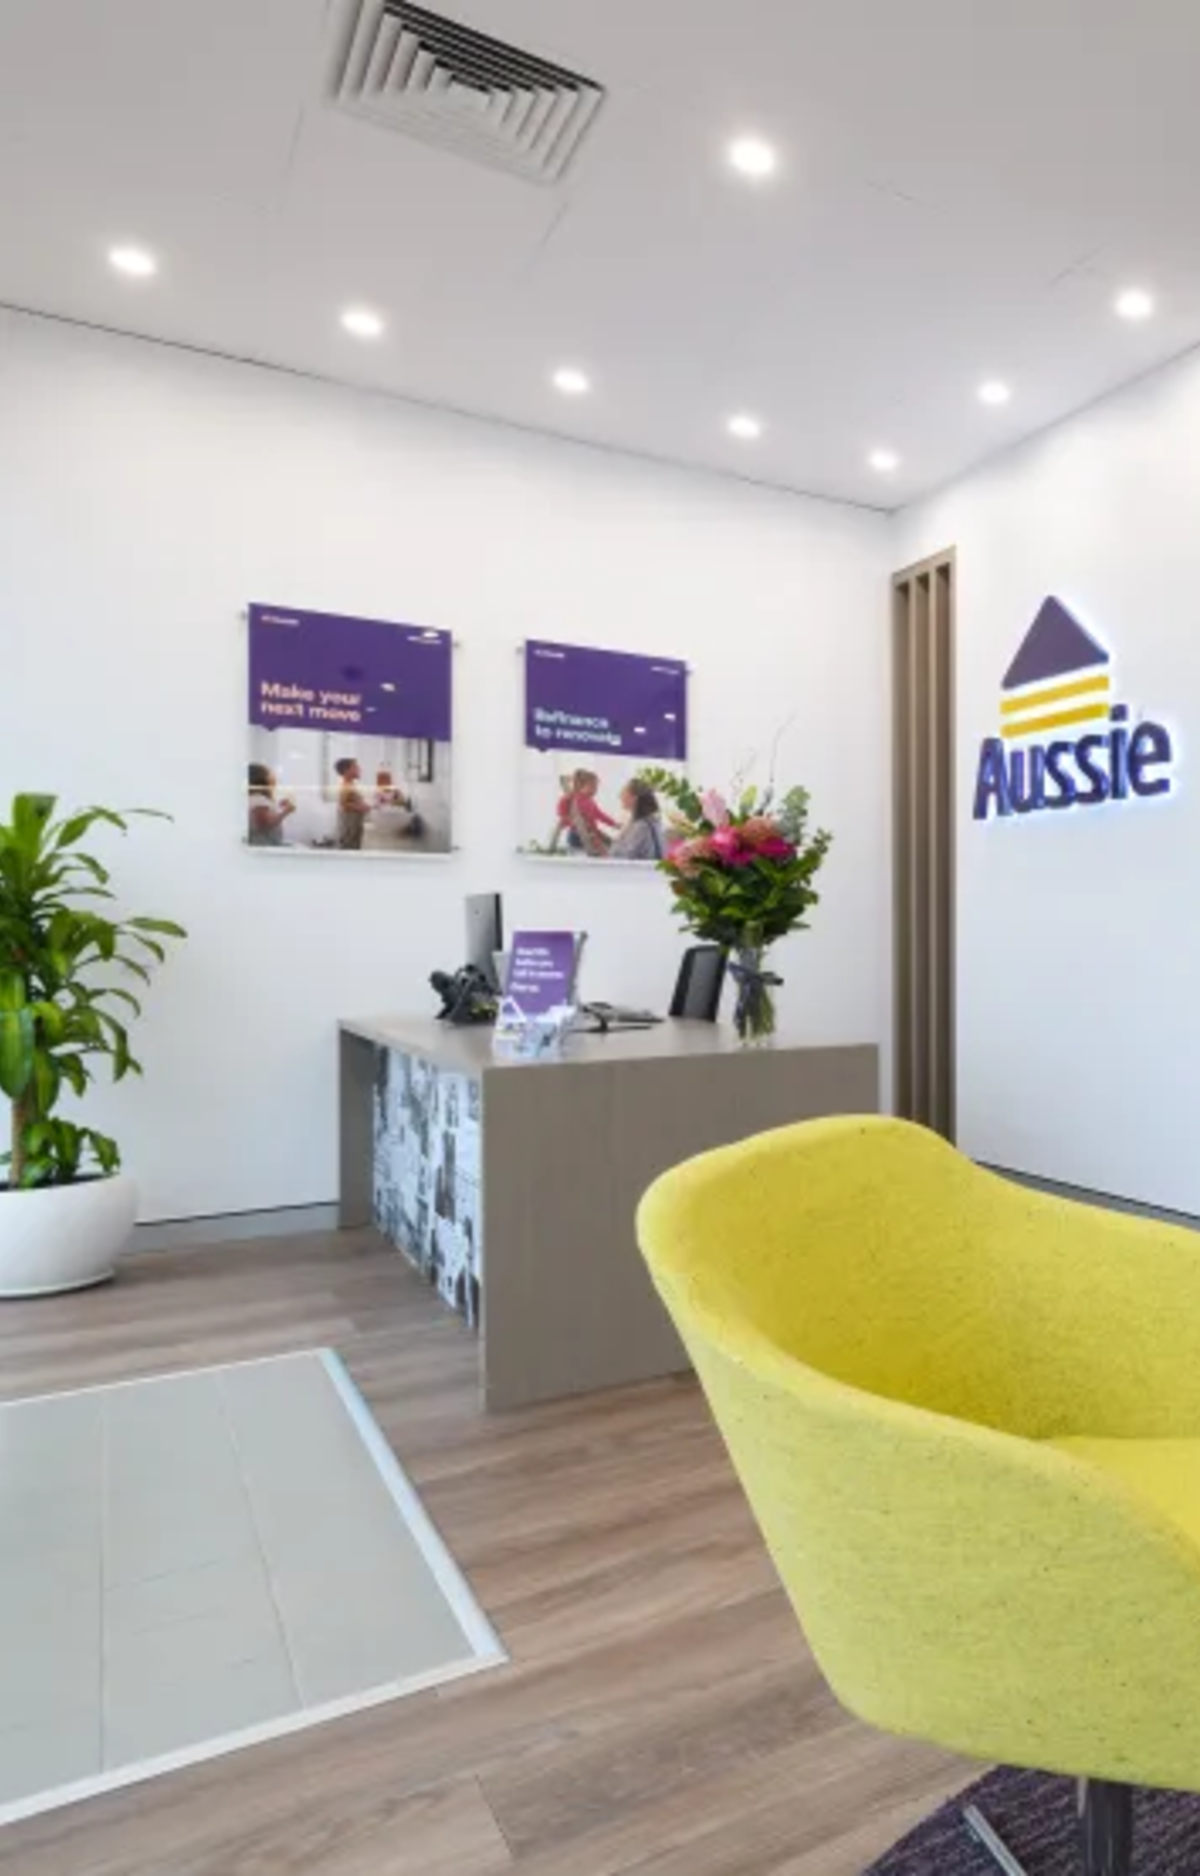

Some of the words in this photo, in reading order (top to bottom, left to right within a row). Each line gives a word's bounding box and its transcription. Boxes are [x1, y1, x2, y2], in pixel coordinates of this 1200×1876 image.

[261, 681, 314, 701] Make
[319, 690, 361, 705] your
[261, 701, 303, 718] next
[308, 707, 361, 722] move
[534, 707, 608, 729] Refinance
[535, 724, 551, 739] to
[973, 704, 1171, 820] Aussie
